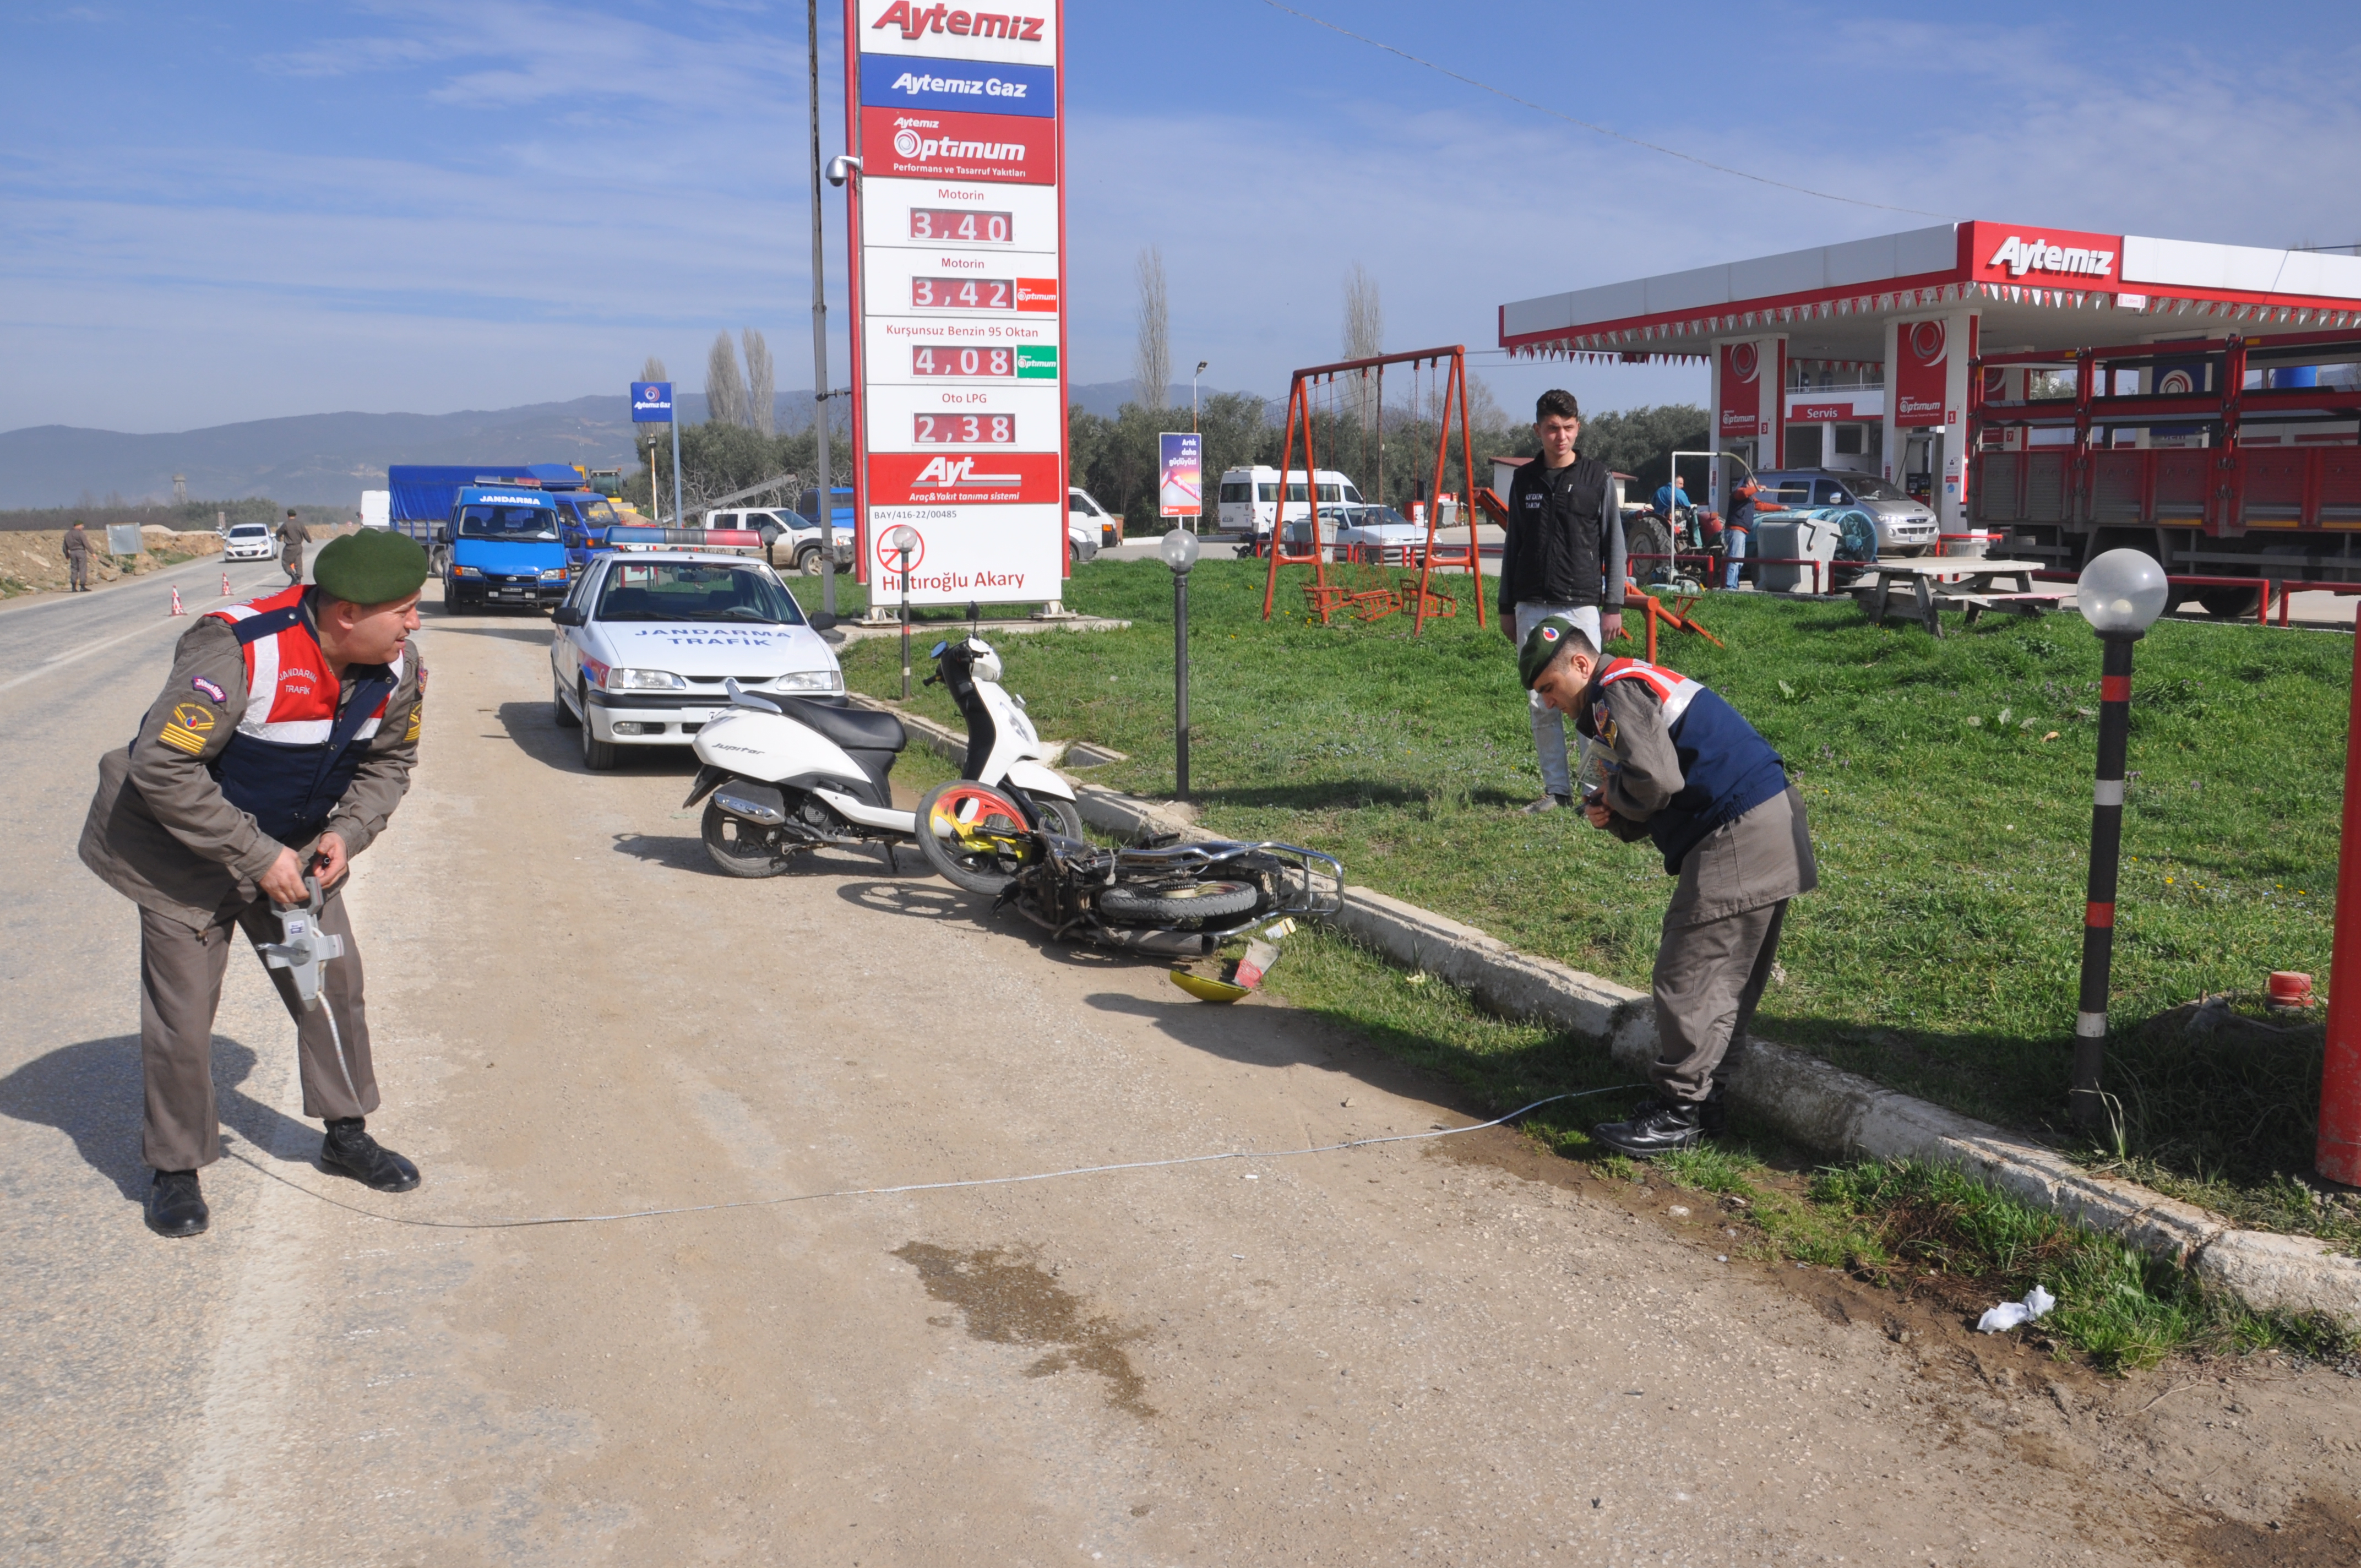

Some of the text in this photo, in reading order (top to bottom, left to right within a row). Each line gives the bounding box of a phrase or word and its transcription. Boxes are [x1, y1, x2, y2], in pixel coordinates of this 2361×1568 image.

[872, 0, 1045, 41] Aytemiz
[891, 73, 1027, 97] Aytemiz Gaz
[894, 117, 939, 128] Aytemiz
[894, 128, 1025, 161] Optimum
[894, 163, 942, 173] Performans
[956, 166, 990, 175] Tasarruf
[992, 168, 1026, 177] Yakıtları
[938, 189, 984, 200] Motorin
[914, 211, 1007, 241] 3,40
[1988, 236, 2114, 275] Aytemiz
[941, 258, 985, 269] Motorin
[915, 277, 1007, 307] 3,42
[1017, 291, 1057, 302] Optimum
[886, 324, 1039, 337] Kurşunsuz Benzin 95 Oktan
[915, 347, 1008, 374] 4,08
[1018, 358, 1057, 369] Optimum
[942, 393, 987, 404] Oto LPG
[1807, 407, 1838, 418] Servis
[1949, 412, 1955, 422] 1
[917, 415, 1010, 443] 2,38
[1762, 424, 1767, 433] 3
[1181, 447, 1197, 456] daha
[916, 456, 1022, 487] Ayt
[479, 496, 541, 505] JANDARMA
[909, 492, 1020, 503] Araç&Yakıt tanıma sistemi
[874, 510, 958, 520] BAY/416-22/00485
[883, 570, 1025, 592] Hıtıroğlu Akary
[634, 629, 792, 639] JANDARMA
[666, 637, 772, 646] TRAFİK
[279, 668, 318, 684] JANDARMA
[285, 685, 311, 695] TRAFİK
[711, 743, 766, 755] Jupiter
